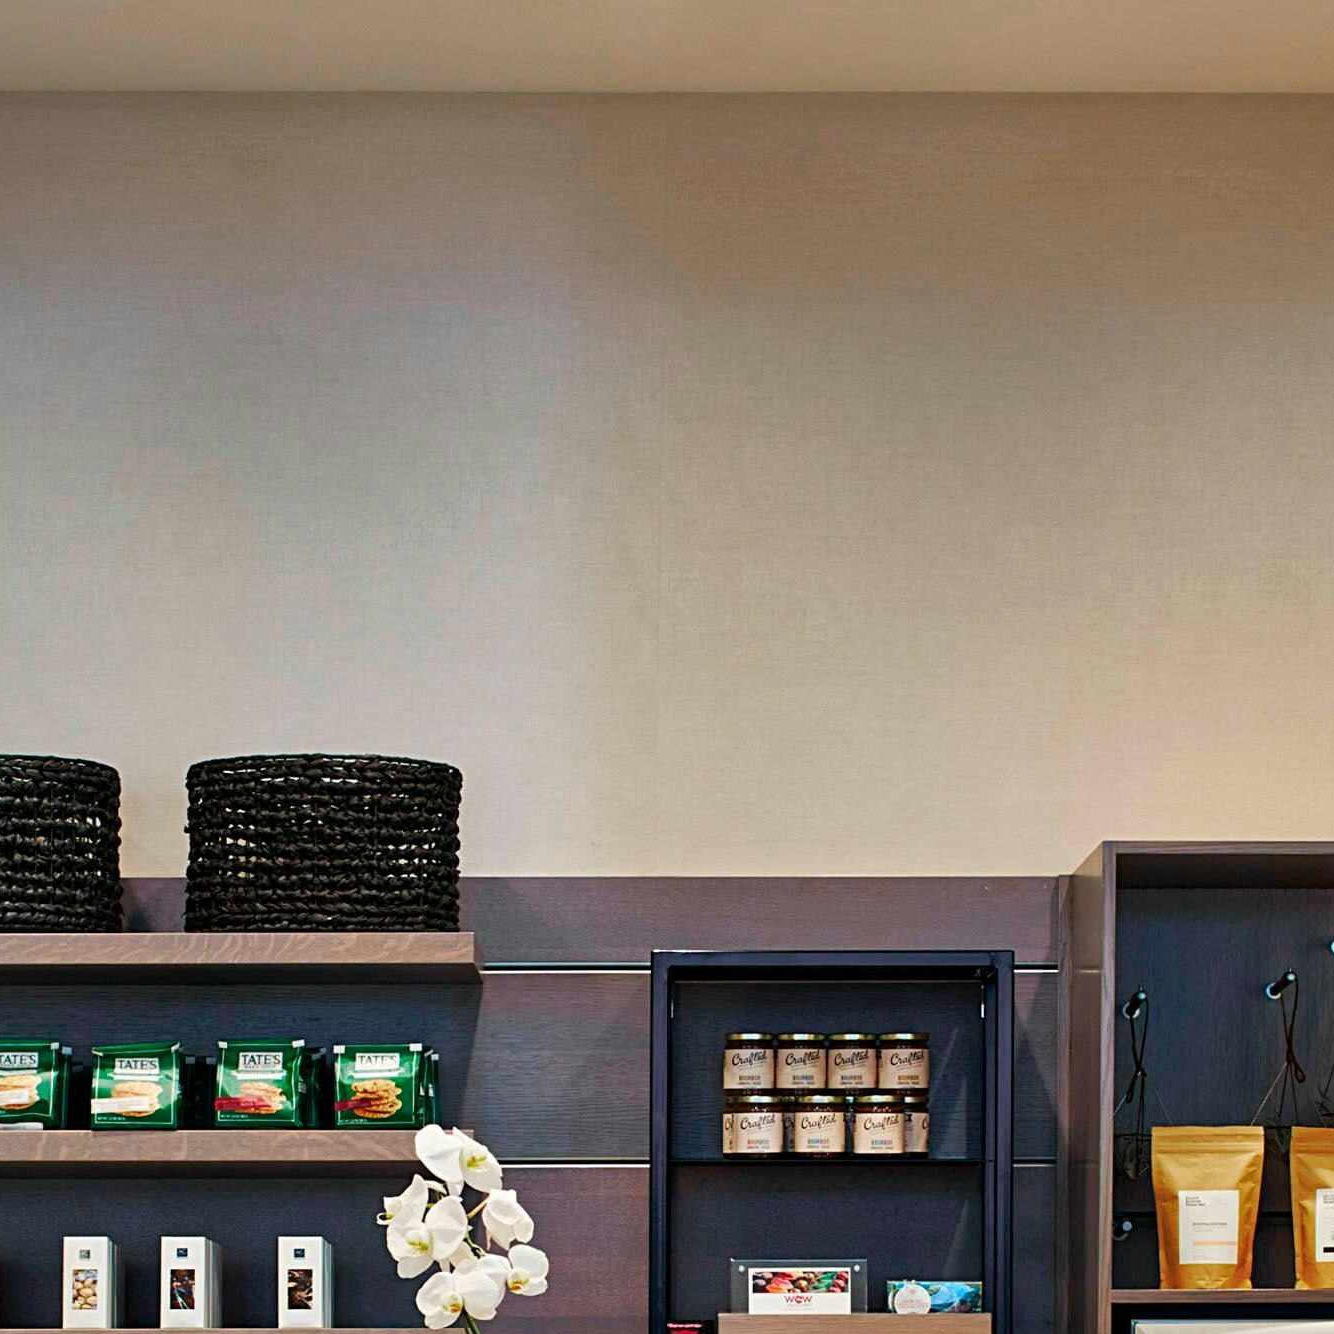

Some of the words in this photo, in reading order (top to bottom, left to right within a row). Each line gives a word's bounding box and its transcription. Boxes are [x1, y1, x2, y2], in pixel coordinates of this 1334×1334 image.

[732, 1050, 768, 1066] Crafted
[785, 1050, 821, 1066] Crafted
[834, 1050, 869, 1066] Crafted
[890, 1050, 924, 1066] Crafted
[740, 1113, 777, 1130] Crafted
[801, 1113, 837, 1130] Crafted
[864, 1114, 899, 1131] Crafted
